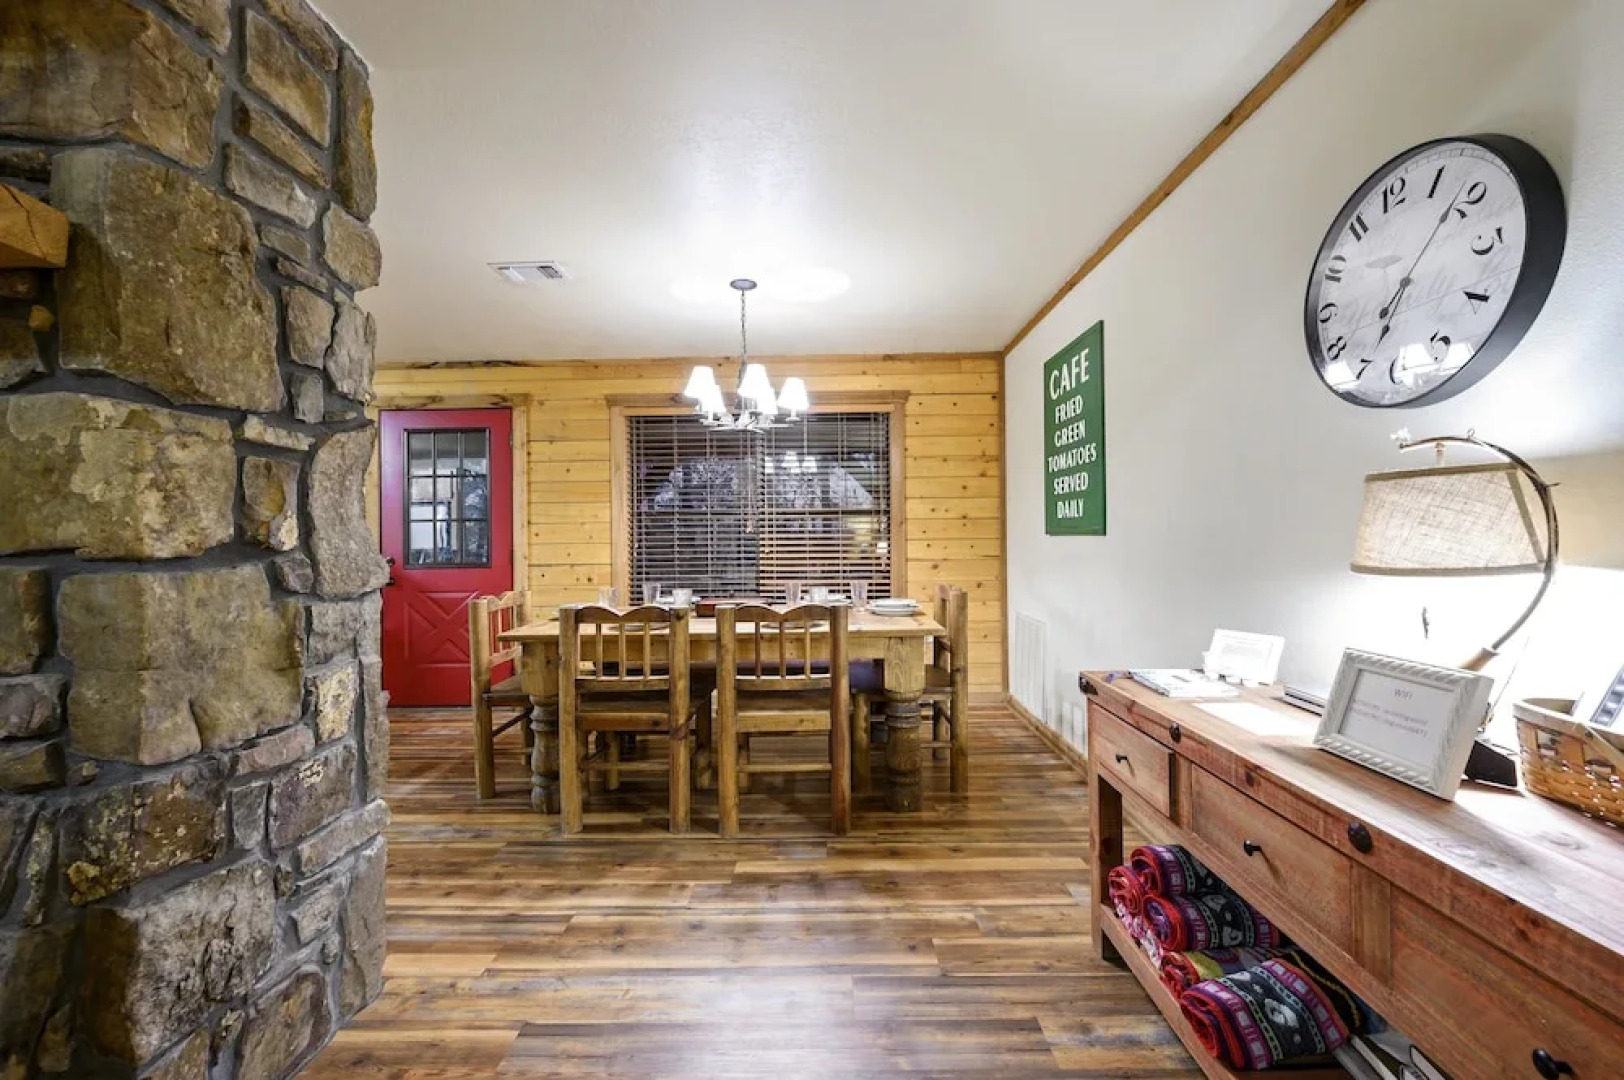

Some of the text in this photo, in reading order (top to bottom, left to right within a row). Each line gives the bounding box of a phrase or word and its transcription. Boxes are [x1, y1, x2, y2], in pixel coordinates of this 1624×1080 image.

[1381, 176, 1406, 214] 12
[1427, 164, 1446, 199] 1
[1453, 181, 1487, 220] 2
[1349, 214, 1370, 242] 11
[1470, 226, 1503, 256] 3
[1324, 254, 1347, 284] 10
[1319, 301, 1339, 324] 9
[1462, 288, 1491, 315] 4
[1327, 335, 1348, 361] 8
[1430, 329, 1451, 364] 5
[1050, 348, 1090, 400] CAFE
[1355, 358, 1374, 381] 7
[1055, 395, 1083, 424] FRIED
[1054, 420, 1086, 447] GREEN
[1047, 443, 1097, 473] TOMATOES
[1053, 472, 1089, 495] SERVED
[1056, 499, 1084, 519] DAILY
